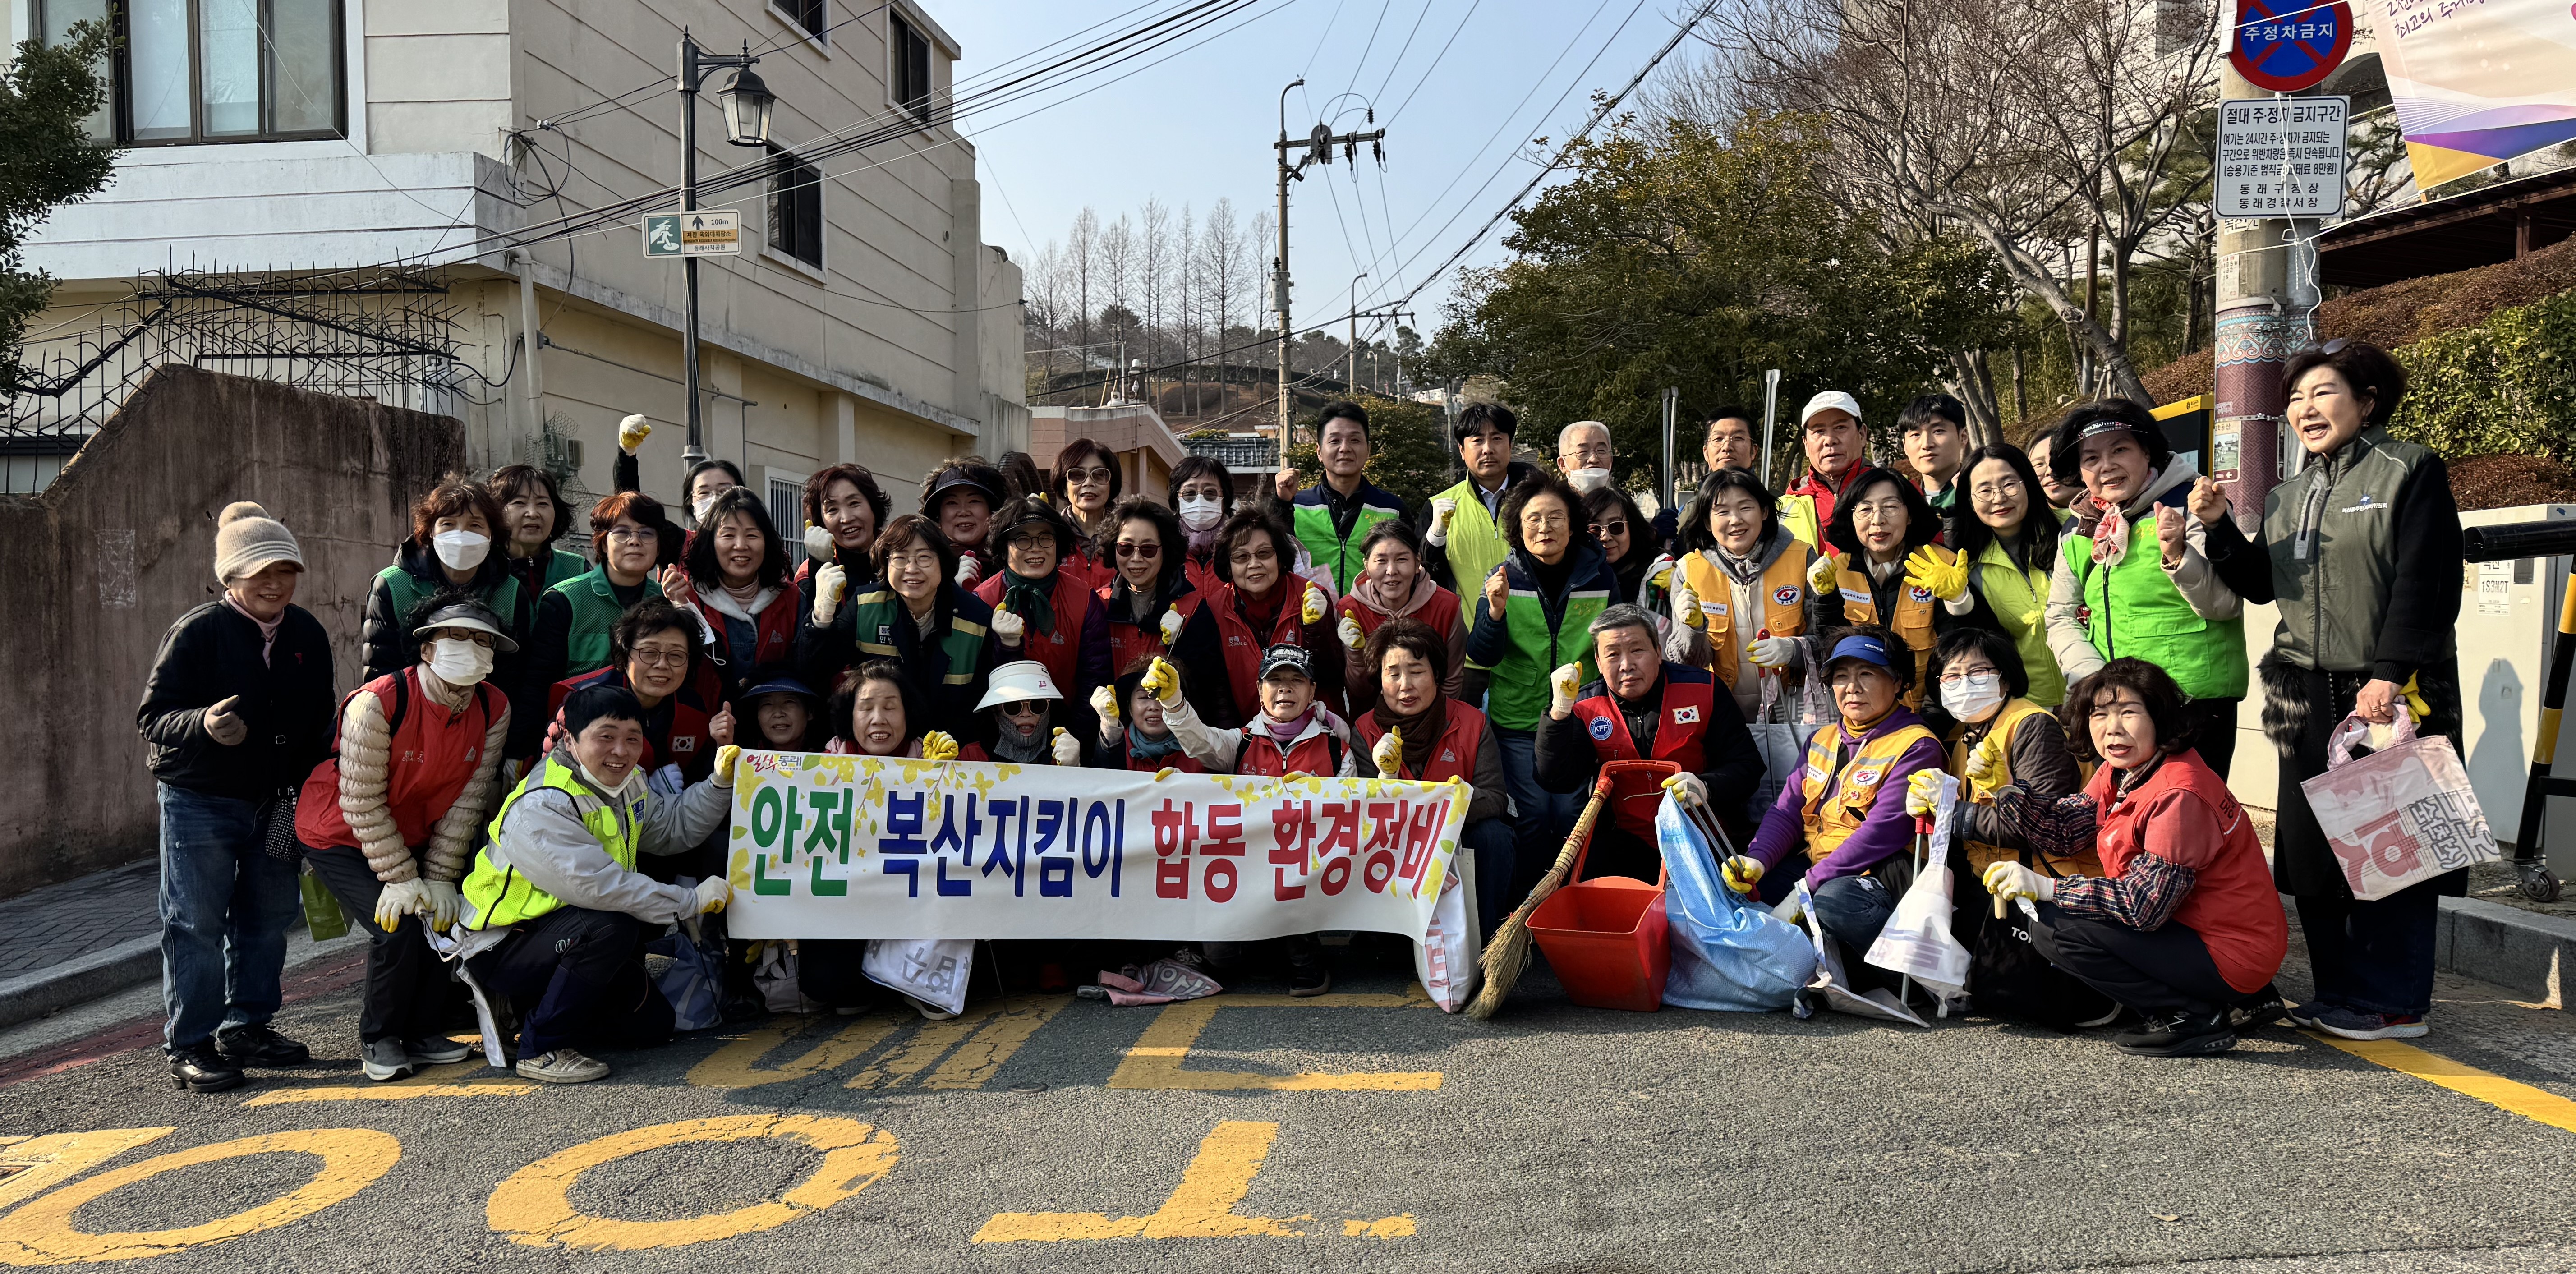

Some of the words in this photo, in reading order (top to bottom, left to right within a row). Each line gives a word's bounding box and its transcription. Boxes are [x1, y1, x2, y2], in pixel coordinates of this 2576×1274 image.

[2394, 7, 2434, 39] 최고의
[2244, 22, 2333, 42] 주정차금지
[2227, 108, 2249, 124] 절대
[2293, 105, 2341, 123] 금지구간
[2223, 133, 2244, 146] 여기는
[2245, 133, 2268, 145] 24시간
[2302, 131, 2330, 144] 금지되는
[2222, 149, 2249, 161] 구간으로
[2252, 148, 2285, 161] 위반차량은
[2288, 147, 2302, 159] 즉시
[2305, 147, 2341, 159] 단속됩니다.
[2224, 164, 2258, 177] (승용기준
[2314, 162, 2337, 175] 8만원)
[2482, 580, 2509, 593] 1S3N2T
[1594, 724, 1608, 733] KFF
[779, 756, 802, 766] 동래
[752, 786, 853, 897] 안전
[878, 791, 1125, 898] 복산지킴이
[1152, 799, 1246, 903] 합동
[1269, 800, 1450, 901] 환경정비
[2012, 926, 2032, 943] TO
